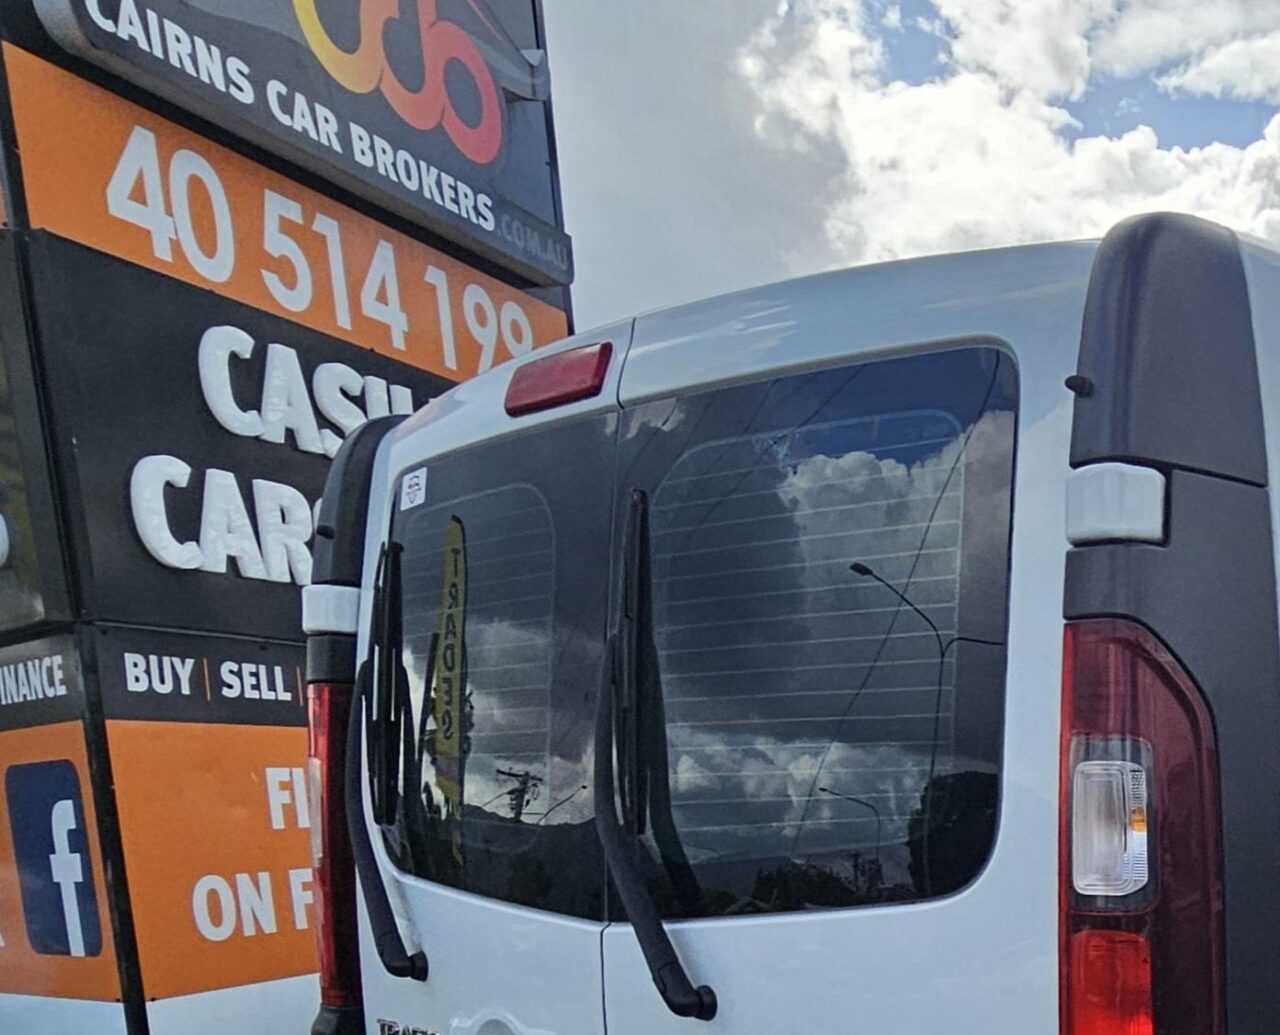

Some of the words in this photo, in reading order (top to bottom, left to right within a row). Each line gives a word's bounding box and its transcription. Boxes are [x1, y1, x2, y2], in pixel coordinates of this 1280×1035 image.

[84, 0, 256, 104] CAIRNS
[266, 79, 343, 154] CAR
[349, 121, 496, 231] BROKERS
[106, 124, 235, 283] 40
[260, 188, 409, 351] 514
[130, 454, 323, 586] CAR
[124, 652, 195, 696] BUY
[220, 661, 292, 702] SELL
[193, 870, 278, 941] ON
